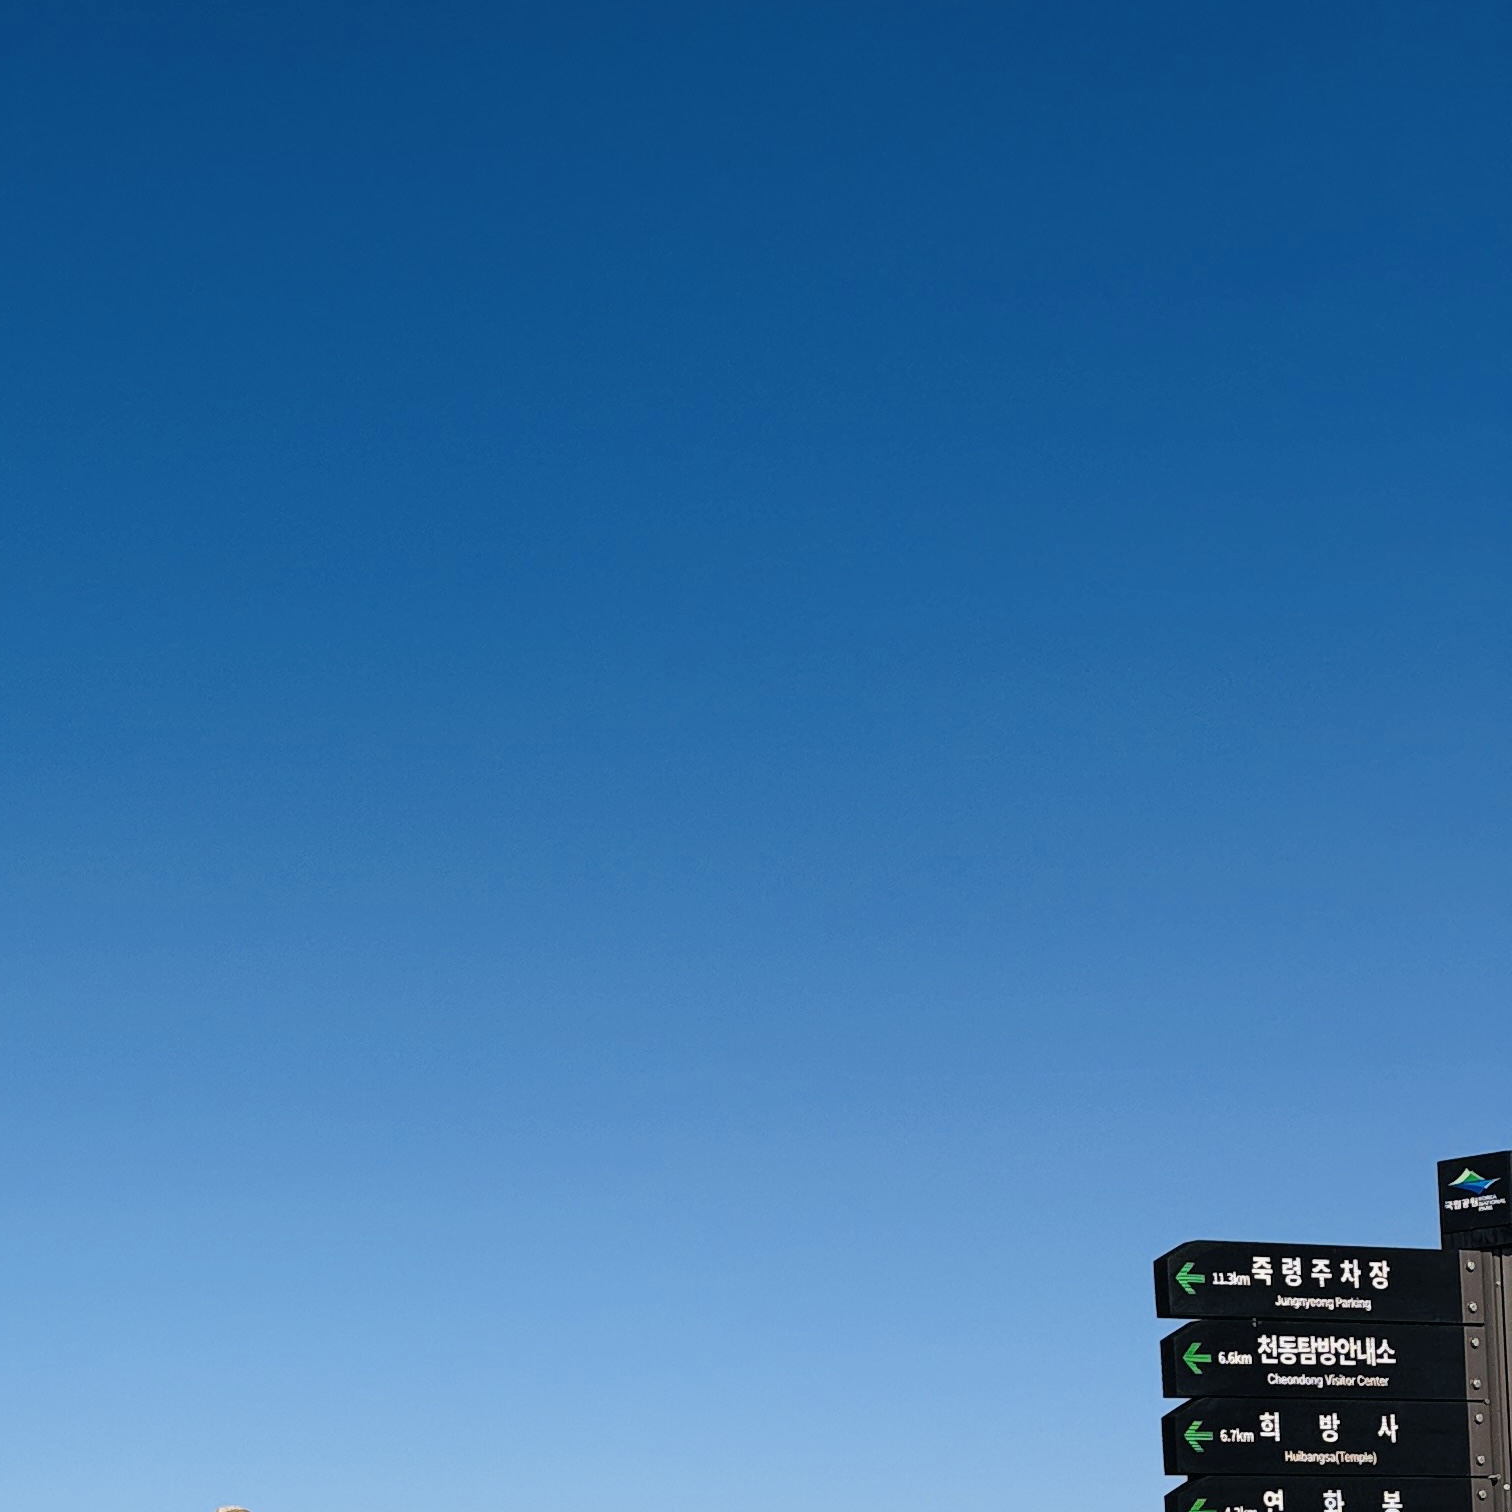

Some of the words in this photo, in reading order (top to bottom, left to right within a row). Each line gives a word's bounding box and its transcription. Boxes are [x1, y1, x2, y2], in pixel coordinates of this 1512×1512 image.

[1335, 1297, 1371, 1311] Parking
[1218, 1351, 1252, 1364] 6.6km
[1258, 1335, 1396, 1366] 천동탐방안내소
[1268, 1373, 1323, 1388] Cheondong
[1325, 1374, 1356, 1386] Visitor
[1357, 1375, 1389, 1386] Center
[1220, 1428, 1254, 1442] 6.7km
